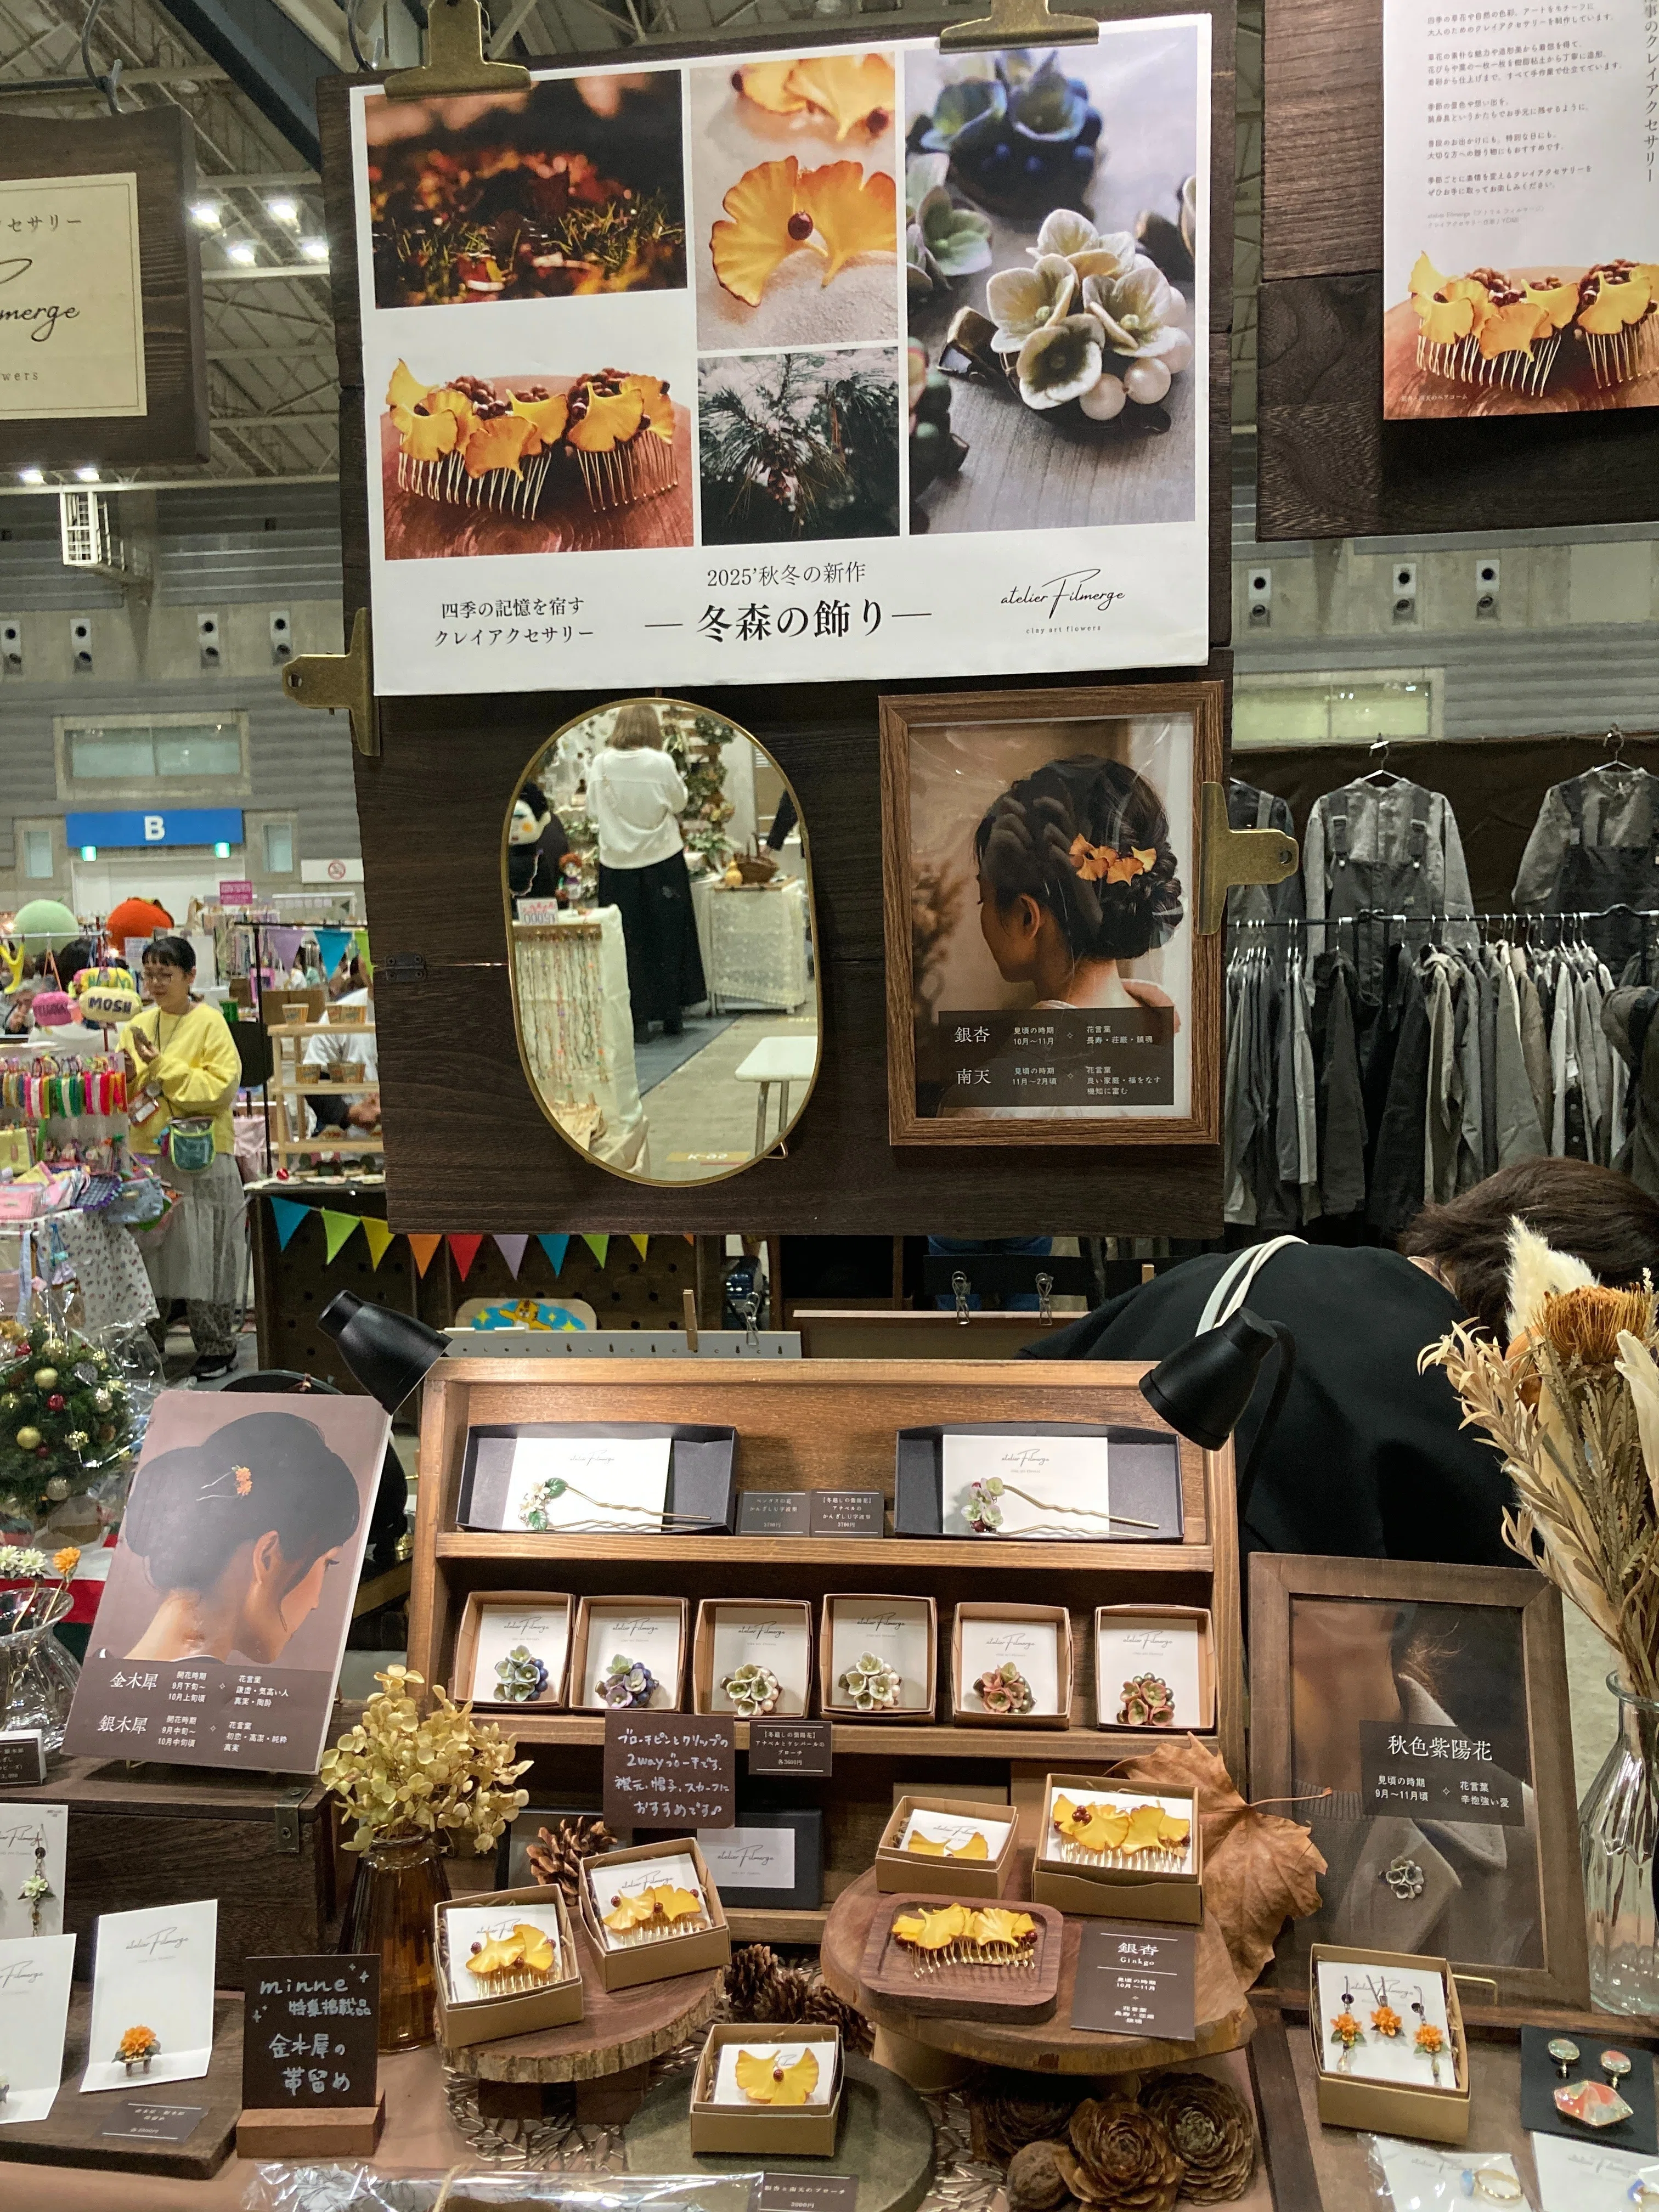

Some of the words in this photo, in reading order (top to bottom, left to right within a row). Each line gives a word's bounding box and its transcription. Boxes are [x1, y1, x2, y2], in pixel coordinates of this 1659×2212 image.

[1001, 586, 1047, 605] atelier
[1041, 568, 1126, 619] Filmerge
[441, 597, 585, 619] 四季の記憶を宿す
[435, 625, 594, 647] クレイアクセサリー
[144, 815, 166, 841] B
[954, 1026, 990, 1043] 銀杏
[1013, 1026, 1054, 1035] 見頃の時期
[1086, 1025, 1112, 1034] 花言葉
[956, 1068, 992, 1085] 南天
[1014, 1066, 1056, 1076] 見頃の時期
[1086, 1066, 1112, 1075] 花言葉
[110, 1671, 159, 1691] 金木犀
[176, 1671, 206, 1681] 開花時期
[238, 1675, 262, 1684] 花言葉
[97, 1715, 148, 1735] 銀木犀
[166, 1715, 197, 1725] 開花時期
[228, 1722, 252, 1730] 花言葉
[618, 1728, 729, 1747] ブローチピンとクリップの
[1387, 1734, 1493, 1762] 秋色紫陽花
[1378, 1775, 1426, 1788] 見頃の時期
[1460, 1780, 1490, 1792] 花言葉
[1460, 1795, 1510, 1809] 辛抱強い愛
[1118, 1942, 1159, 1956] 銀杏
[1120, 1956, 1154, 1967] Ginkgo
[259, 1978, 348, 1995] minne
[283, 2066, 351, 2096] 帯留め
